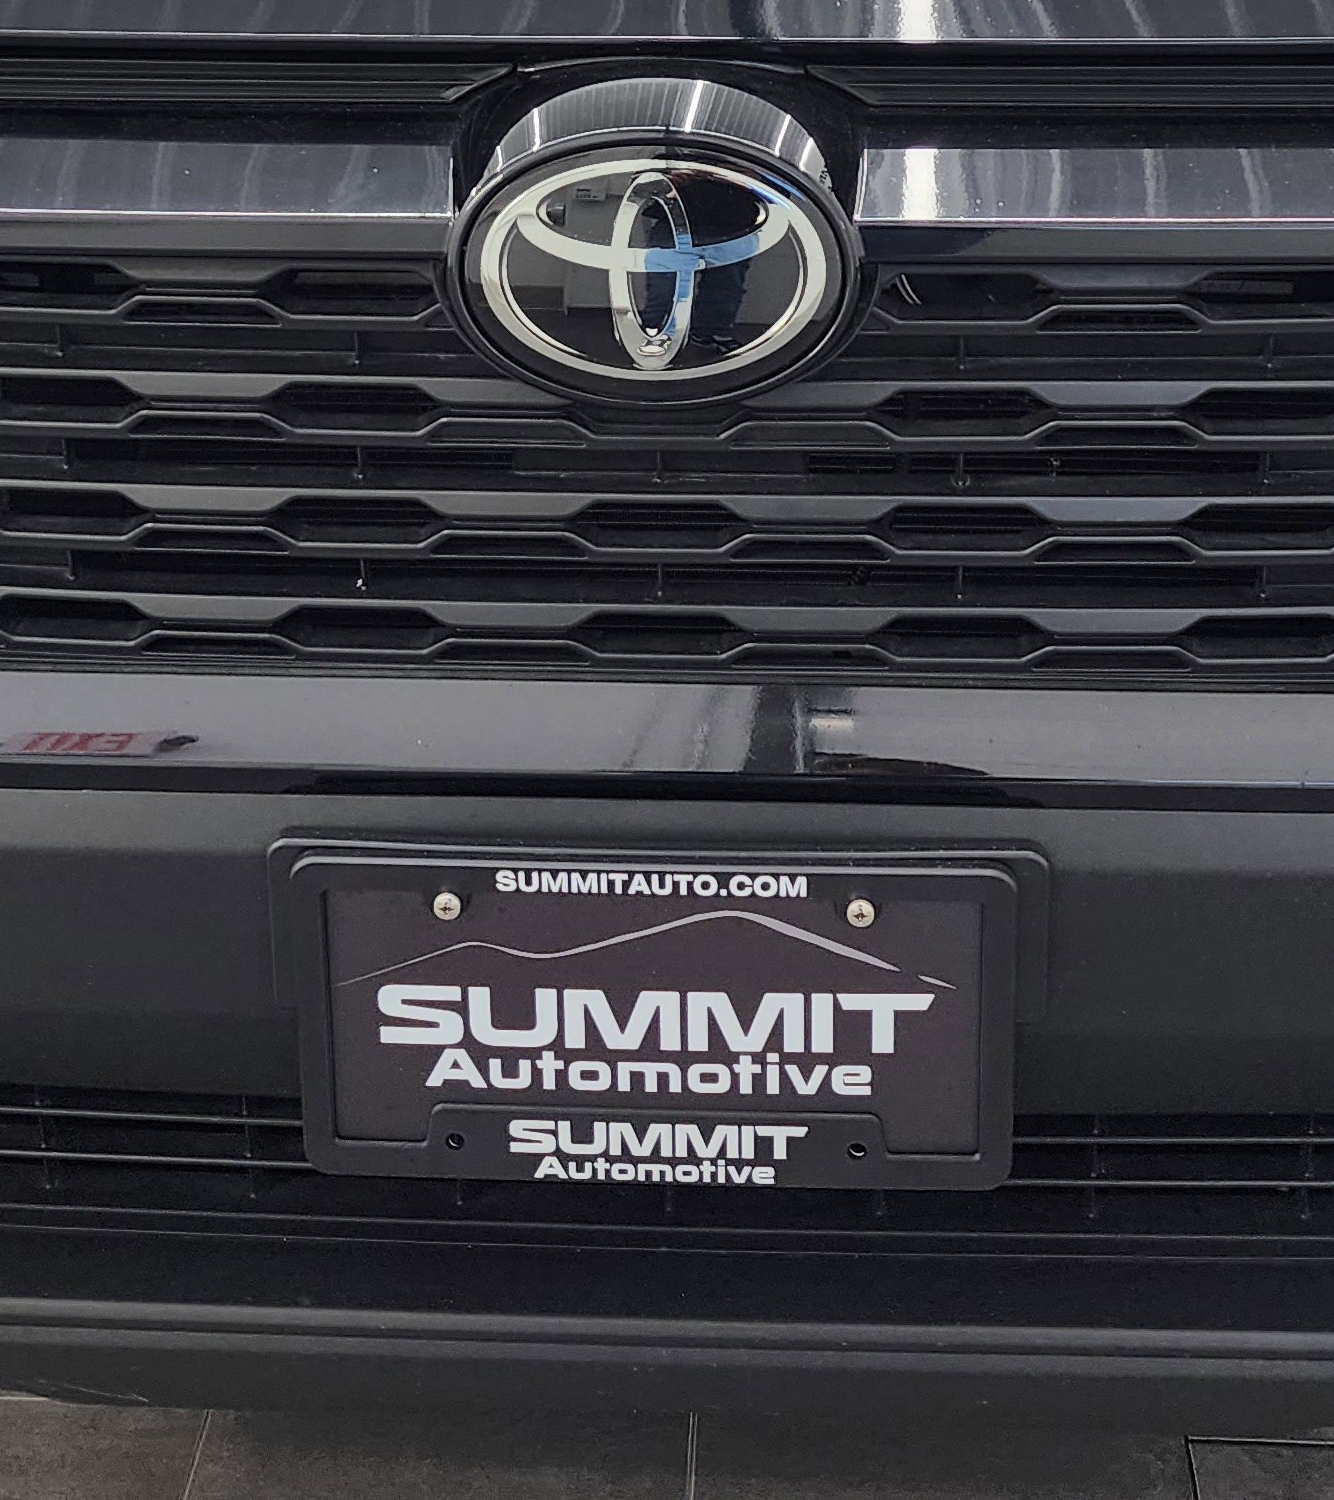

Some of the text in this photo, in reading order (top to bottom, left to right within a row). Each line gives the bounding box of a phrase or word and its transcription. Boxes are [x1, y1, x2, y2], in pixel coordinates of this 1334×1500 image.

[495, 869, 808, 898] SUMMITAUTO.COM
[376, 983, 936, 1054] SUMMIT
[425, 1047, 873, 1096] Automotive
[508, 1119, 809, 1160] SUMMIT
[533, 1155, 777, 1185] Automotive
